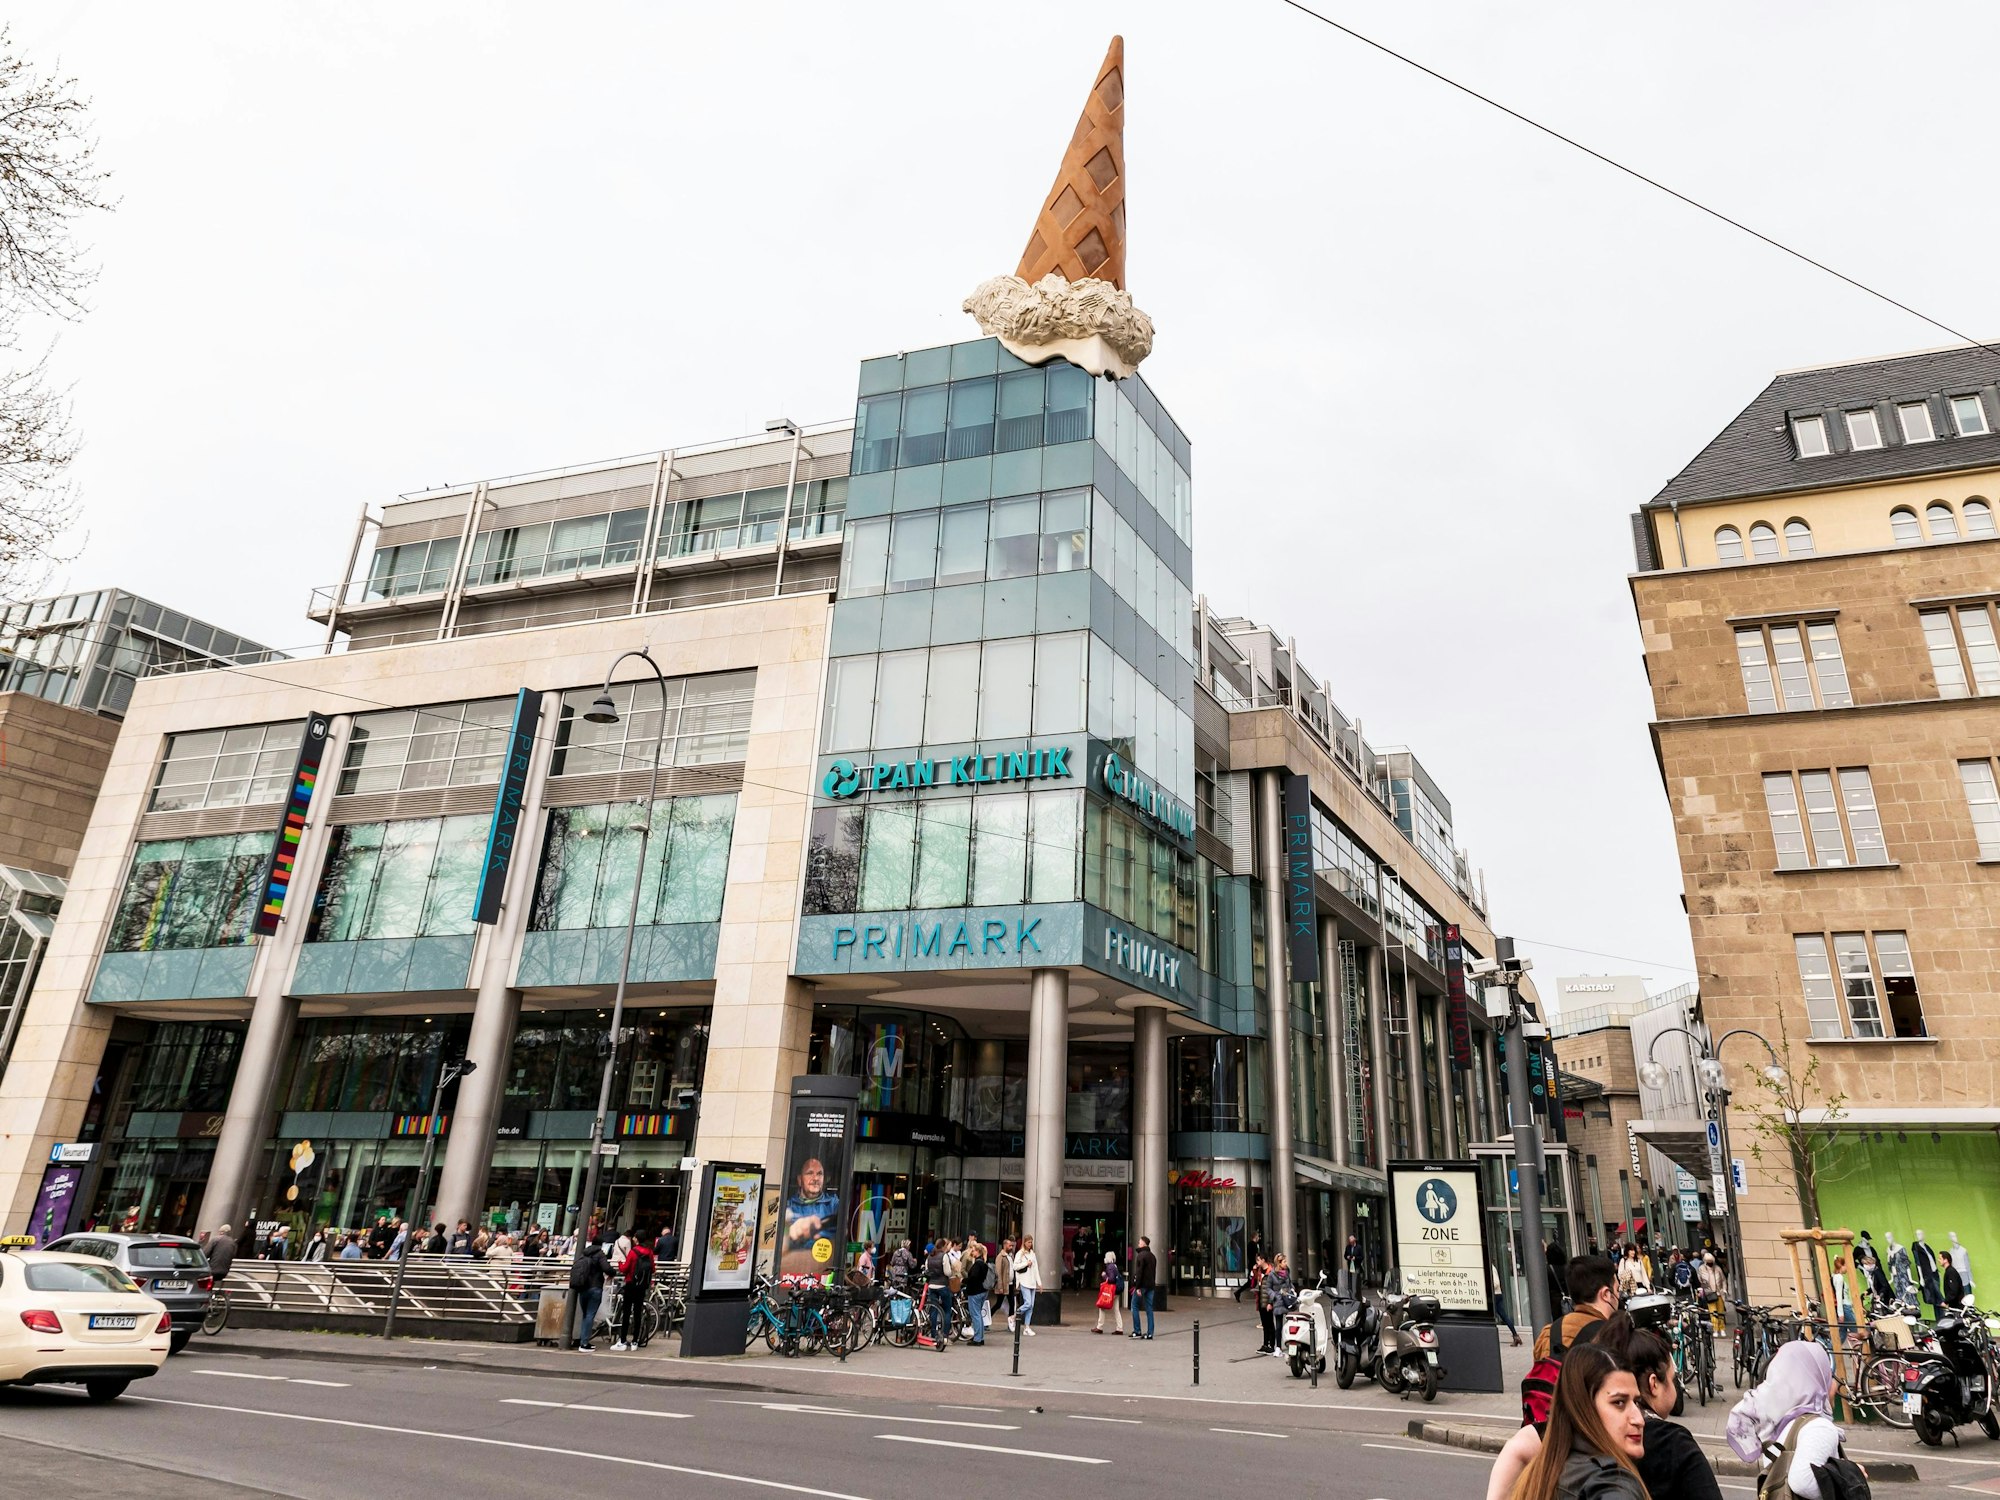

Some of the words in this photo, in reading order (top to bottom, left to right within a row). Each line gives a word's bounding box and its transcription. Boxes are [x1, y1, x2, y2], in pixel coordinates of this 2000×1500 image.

[313, 724, 325, 735] M
[872, 758, 934, 790] PAN
[950, 747, 1070, 784] KLINIK
[1124, 770, 1151, 814] PAN
[490, 733, 531, 873] PRIMARK
[1289, 814, 1312, 937] PRIMARK
[833, 917, 1042, 961] PRIMARK
[1105, 927, 1182, 991] PRIMARK
[1565, 983, 1615, 993] KARSTADT
[1448, 970, 1470, 1064] APOTHEKE
[1530, 1052, 1541, 1076] PAN
[1545, 1056, 1557, 1099] SUBWAY
[497, 1126, 520, 1135] che.de
[51, 1145, 60, 1159] U
[62, 1147, 90, 1158] Neumarkt
[1011, 1136, 1119, 1155] PARK
[1177, 1170, 1237, 1188] Alice
[256, 1221, 281, 1231] HAPPY
[1422, 1228, 1460, 1241] ZONE
[1417, 1270, 1468, 1279] Lieferfahrzeuge
[117, 1316, 135, 1327] 9177
